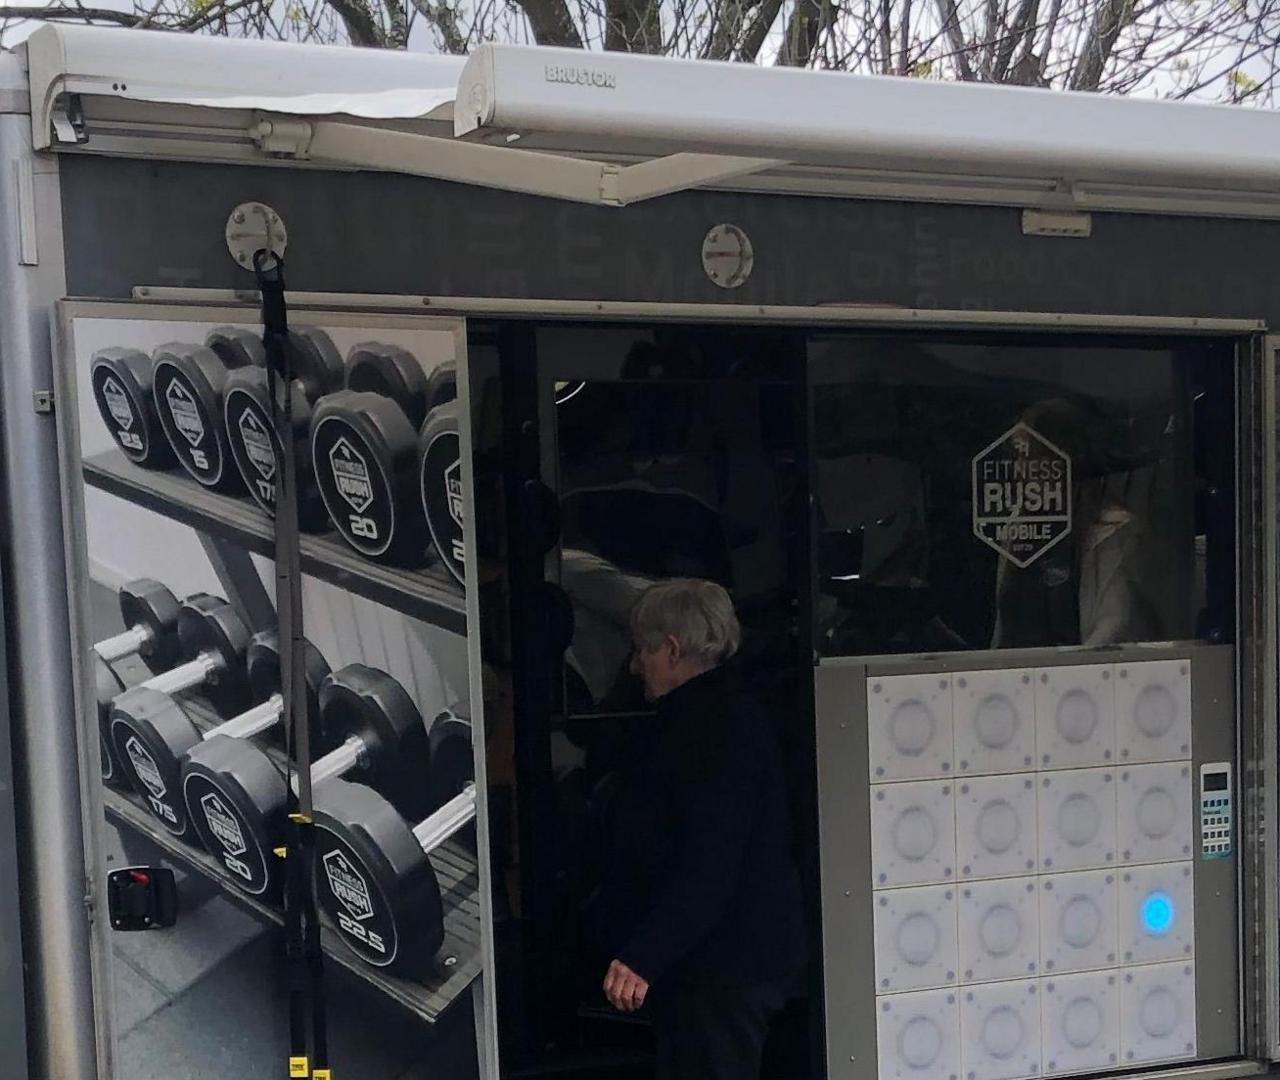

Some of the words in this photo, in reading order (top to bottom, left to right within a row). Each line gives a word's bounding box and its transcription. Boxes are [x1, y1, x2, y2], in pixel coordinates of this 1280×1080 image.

[545, 64, 617, 89] BRUSTOR
[983, 459, 1063, 480] FITNESS
[984, 482, 1063, 513] RUSH
[349, 514, 378, 539] 20
[996, 524, 1052, 540] MOBILE
[223, 851, 252, 881] 20
